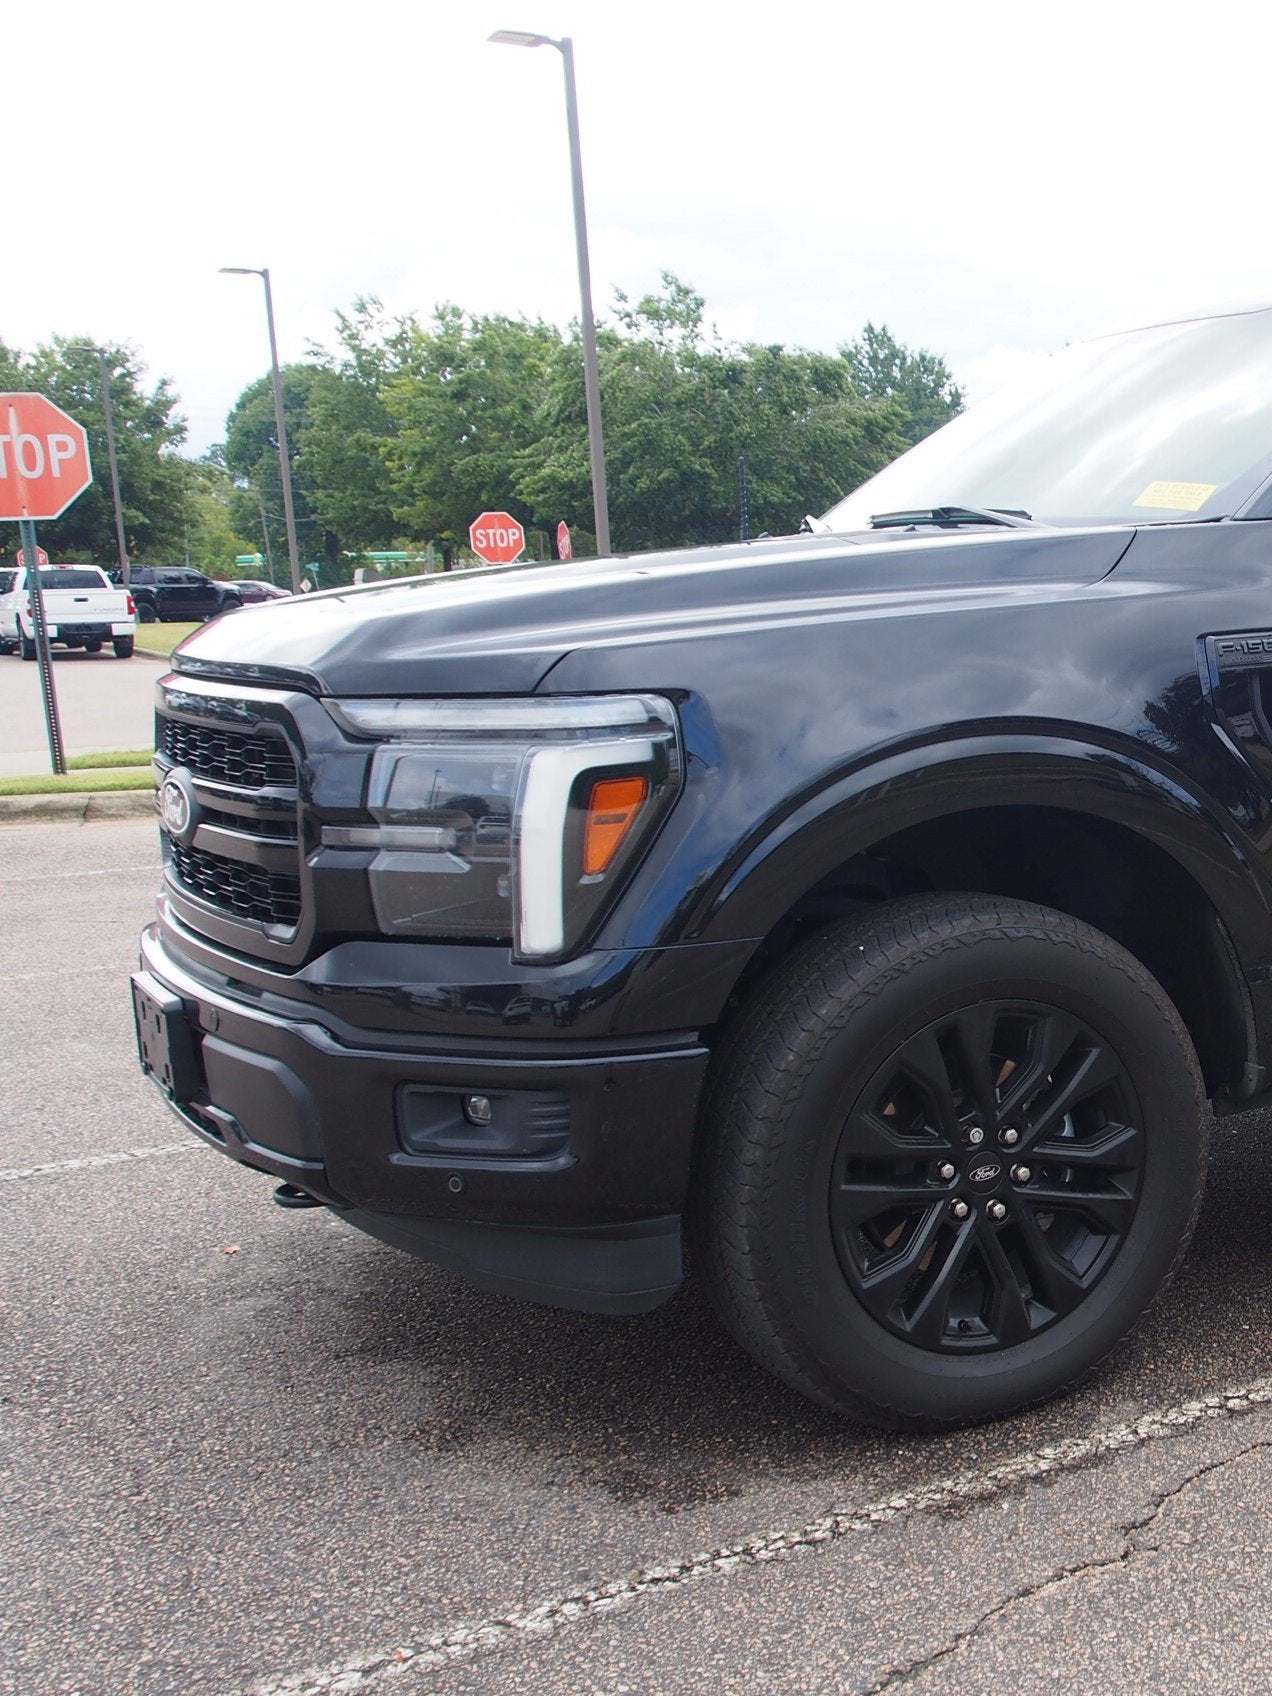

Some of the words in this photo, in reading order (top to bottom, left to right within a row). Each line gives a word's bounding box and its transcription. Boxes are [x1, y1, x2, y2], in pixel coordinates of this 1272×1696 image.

[0, 433, 77, 479] TOP
[475, 528, 520, 548] STOP
[164, 783, 185, 827] Ford
[973, 1166, 997, 1181] Ford
